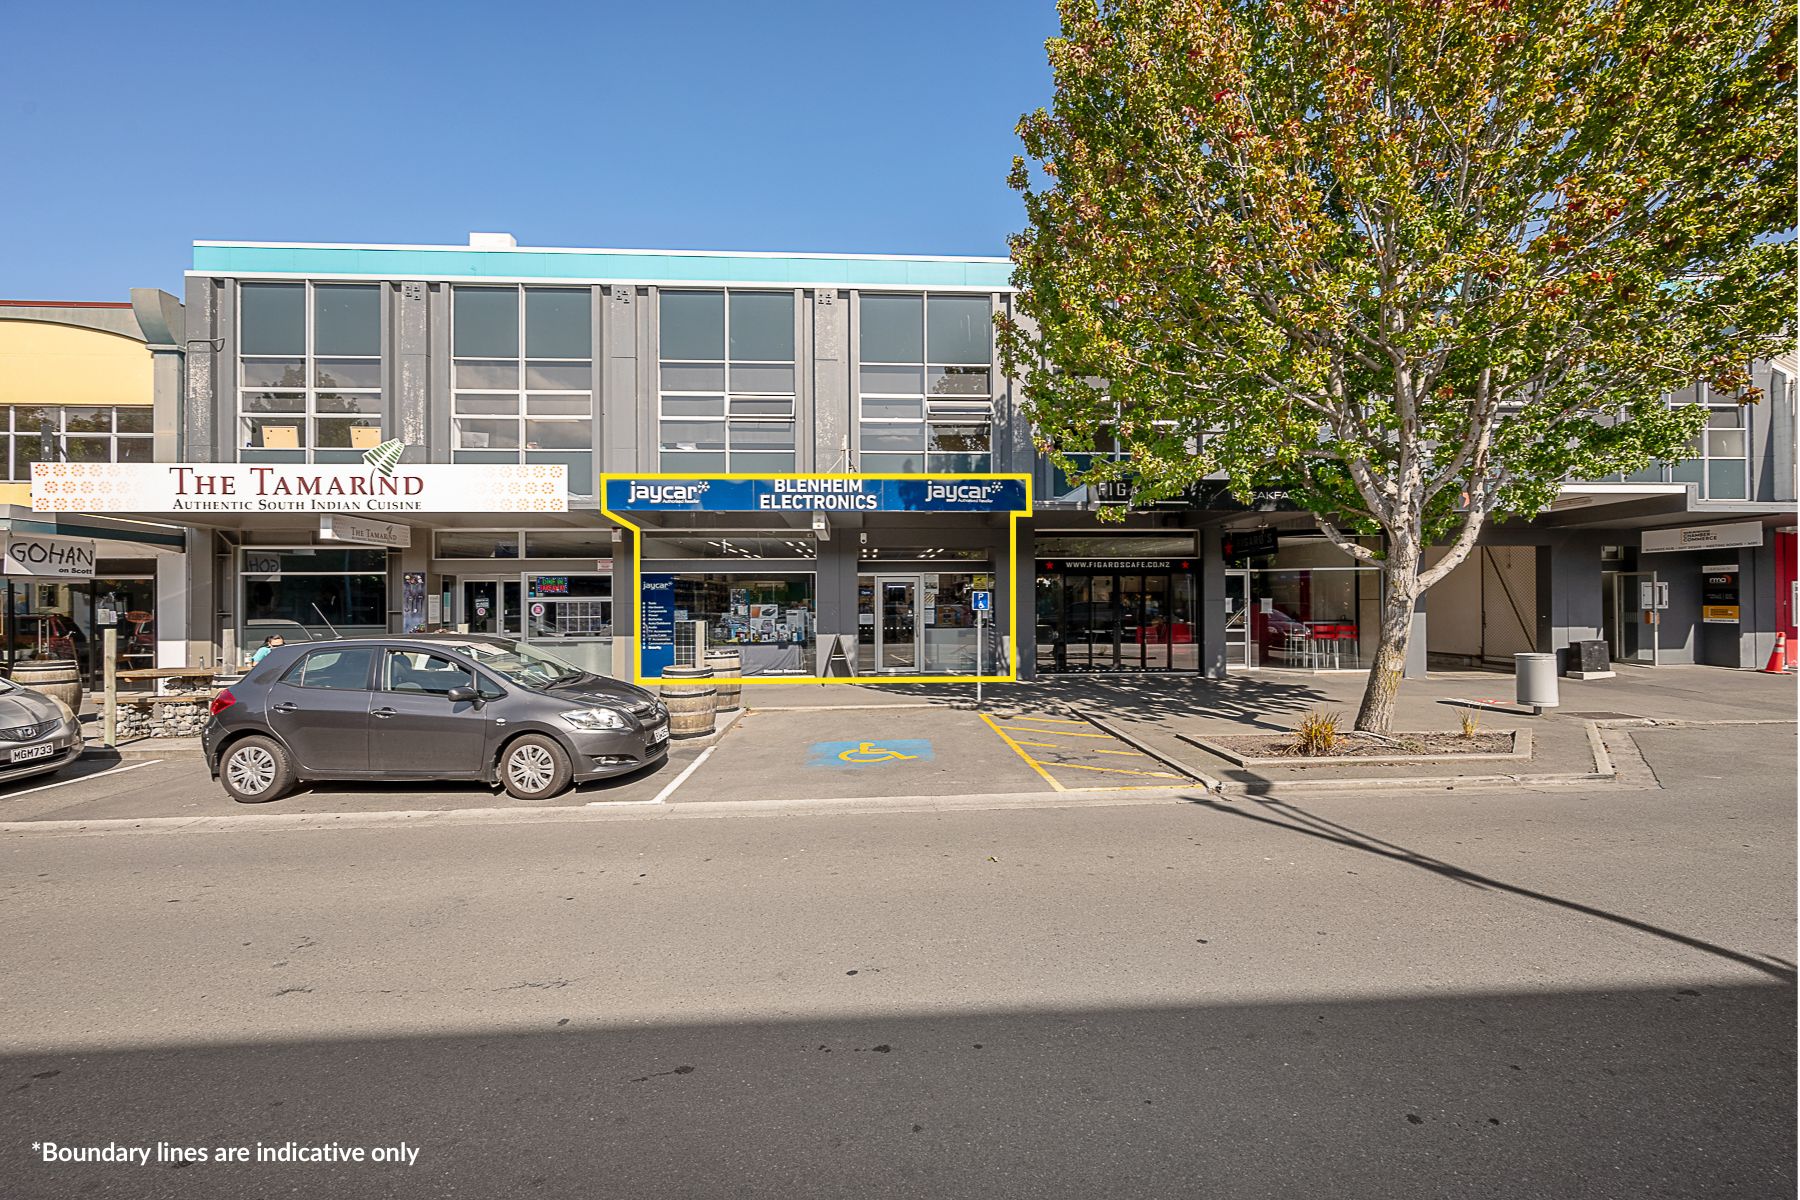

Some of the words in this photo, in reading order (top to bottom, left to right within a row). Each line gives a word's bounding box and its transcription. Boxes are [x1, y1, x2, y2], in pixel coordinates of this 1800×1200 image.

[169, 467, 236, 496] THE
[774, 479, 863, 493] BLENHEIM
[628, 481, 698, 504] jaycar
[925, 481, 992, 503] jaycar
[172, 499, 252, 511] AUTHENTIC
[258, 499, 305, 511] SOUTH
[311, 499, 361, 511] INDIAN
[367, 499, 422, 511] CUISINE
[760, 494, 878, 510] ELECTRONICS
[9, 542, 94, 567] GOHAN
[71, 567, 93, 575] Scott
[1065, 561, 1171, 569] WWW.FIGAROSCAFE.CO.NZ
[642, 581, 669, 591] jaycar
